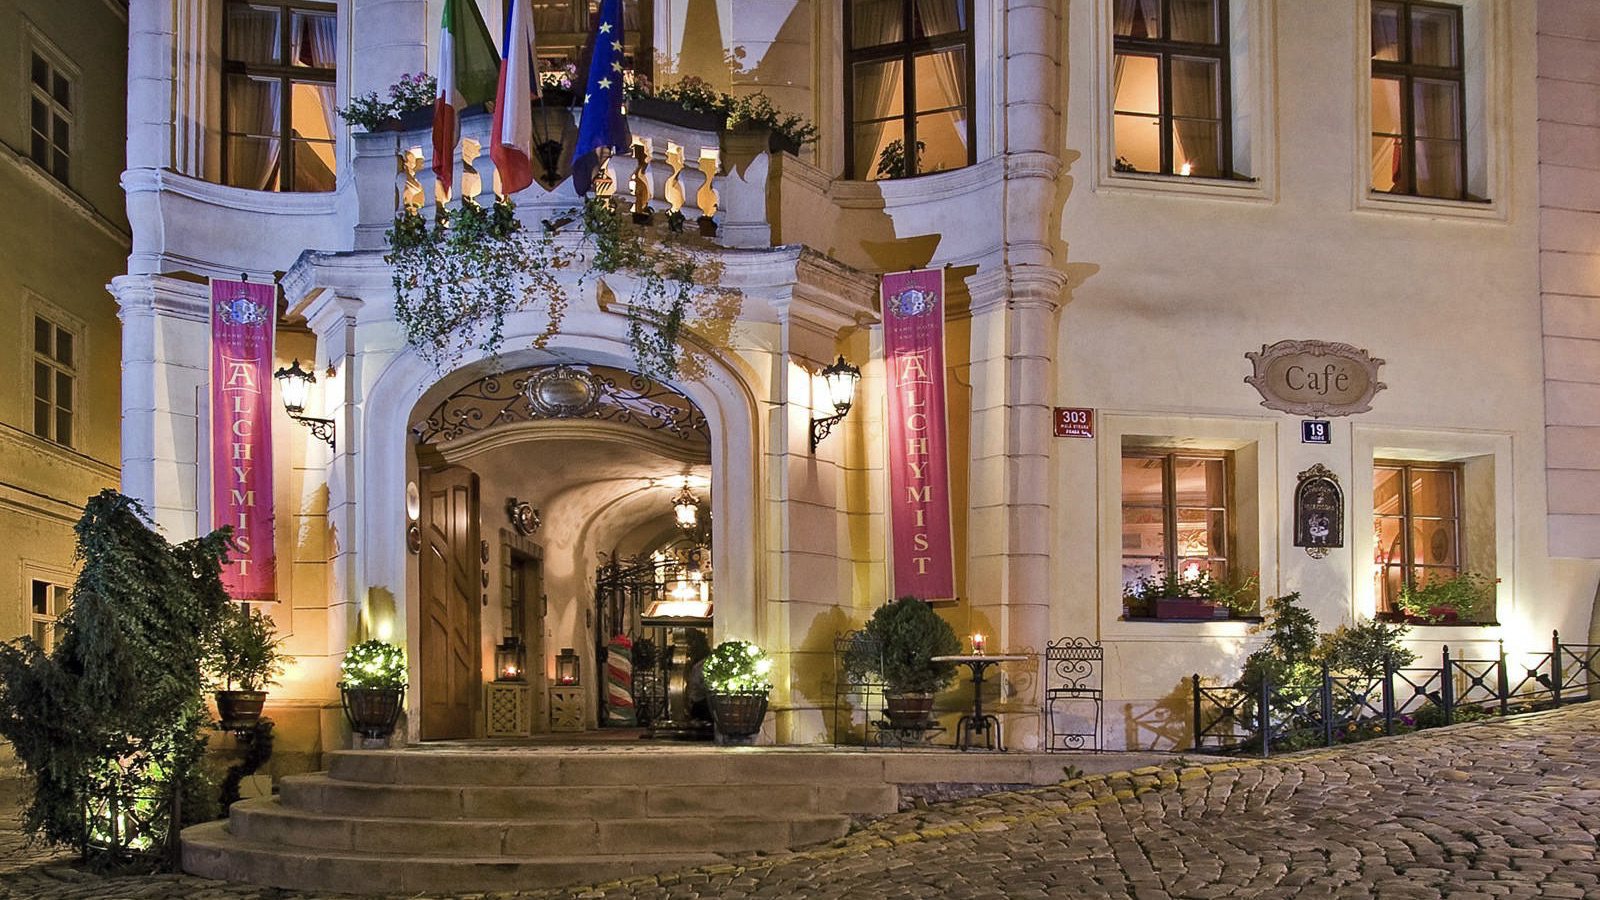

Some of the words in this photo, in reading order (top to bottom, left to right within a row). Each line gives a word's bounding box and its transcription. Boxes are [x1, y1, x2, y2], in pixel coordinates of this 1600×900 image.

[1286, 364, 1349, 396] Café
[1062, 411, 1087, 423] 303
[1310, 423, 1324, 436] 19
[227, 363, 256, 576] ALCHYMIST
[902, 355, 932, 575] ALCHYMIST
